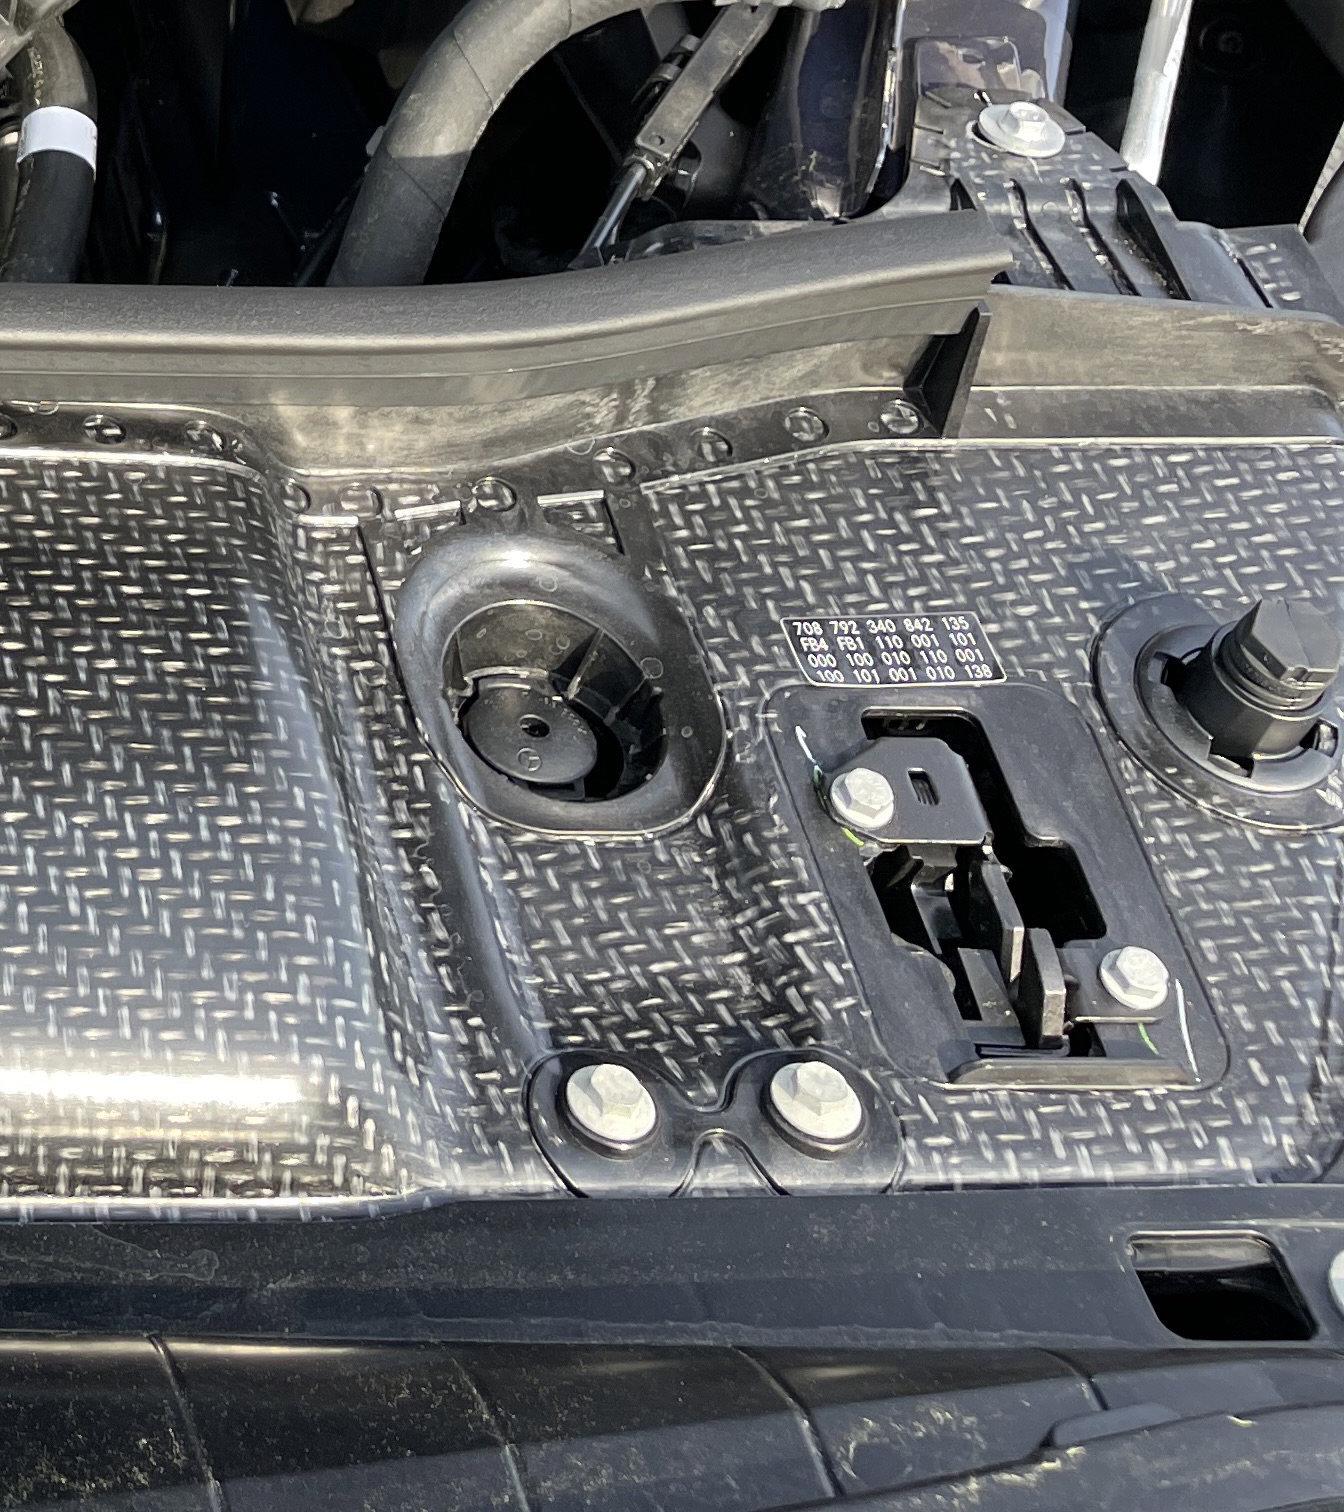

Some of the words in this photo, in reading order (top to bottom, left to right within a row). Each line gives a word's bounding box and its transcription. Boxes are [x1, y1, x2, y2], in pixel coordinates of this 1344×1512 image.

[793, 621, 823, 635] 708
[829, 621, 860, 634] 792
[866, 619, 896, 633] 340
[903, 618, 934, 631] 842
[941, 617, 969, 630] 135
[800, 637, 829, 652] FB4
[836, 636, 865, 651] FB1
[874, 636, 904, 649] 110
[910, 635, 940, 647] 001
[948, 633, 977, 646] 101
[807, 654, 836, 668] 000
[846, 653, 874, 666] 100
[881, 652, 911, 665] 010
[920, 650, 948, 664] 110
[955, 649, 984, 662] 001
[816, 670, 845, 682] 100
[853, 669, 880, 683] 101
[889, 668, 918, 681] 001
[925, 666, 956, 680] 010
[964, 665, 993, 678] 138
